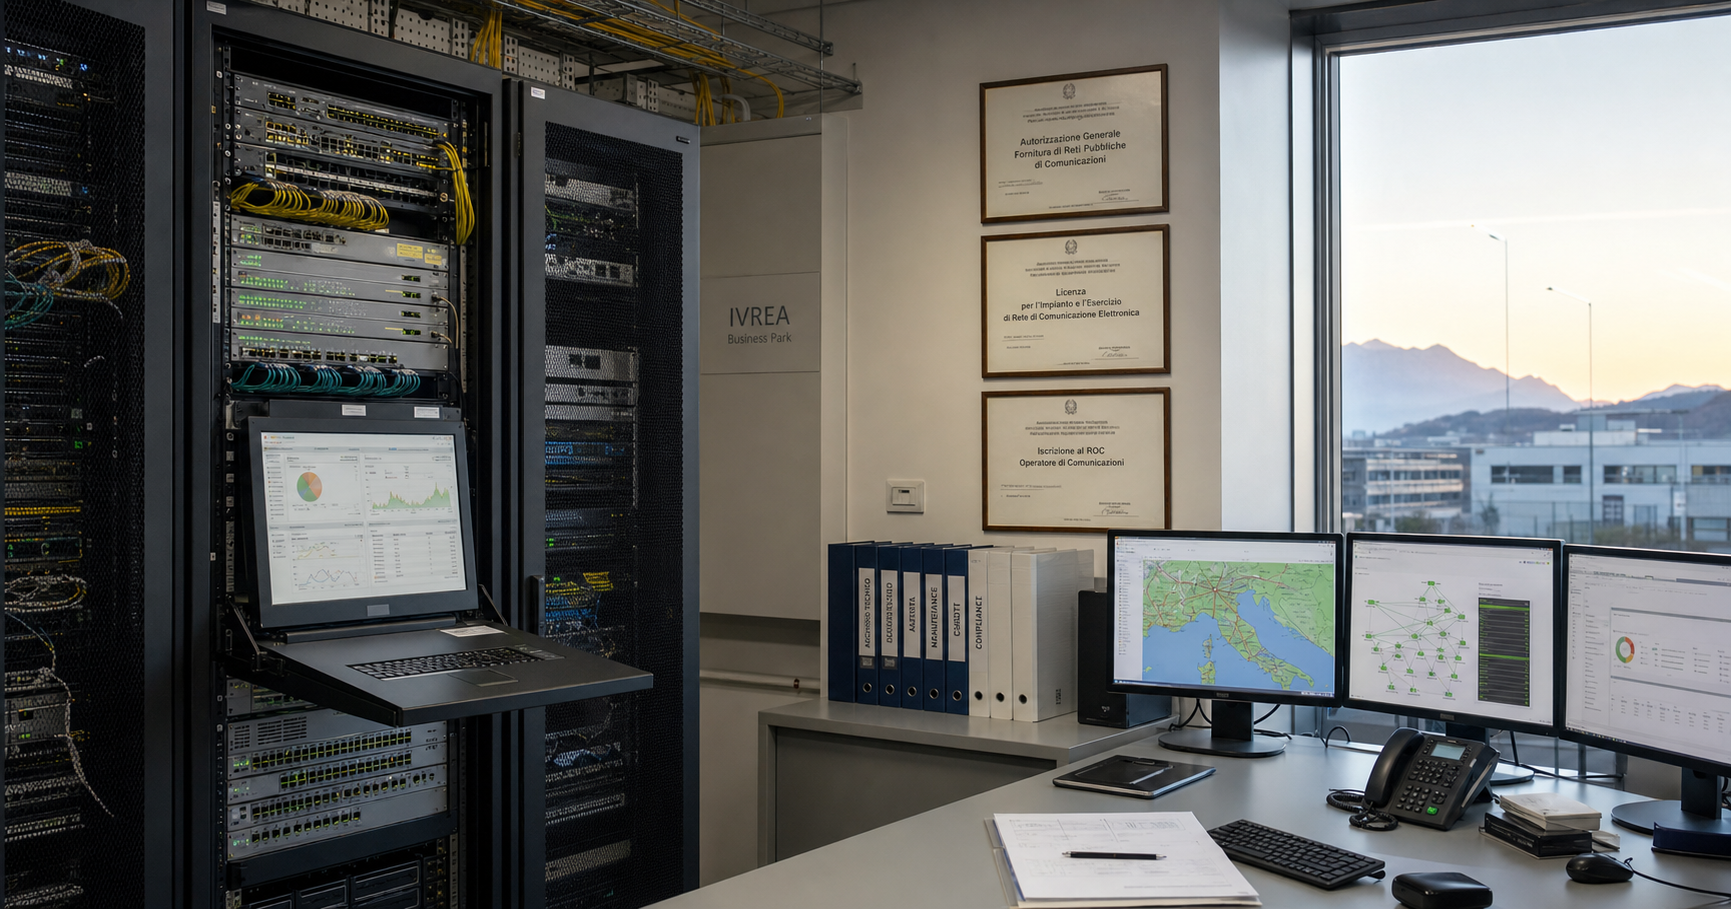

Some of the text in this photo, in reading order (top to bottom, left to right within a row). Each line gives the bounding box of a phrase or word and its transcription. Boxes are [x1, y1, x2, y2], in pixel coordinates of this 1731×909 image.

[1020, 130, 1121, 146] Autorizzazione Generale
[1014, 142, 1126, 159] Fornitura di Reti Pubbliche
[1034, 155, 1106, 169] di Comunicazioni
[1056, 288, 1086, 296] Licenza
[1021, 302, 1034, 311] per
[730, 305, 790, 327] IVREA
[1030, 313, 1037, 321] di
[1039, 311, 1097, 320] Comunicazione
[1099, 308, 1140, 318] Elettronica
[728, 332, 792, 344] Business Park
[1037, 446, 1105, 455] Iscrizione al ROC
[1019, 459, 1056, 468] Operatore
[1067, 458, 1124, 466] Comunicazioni
